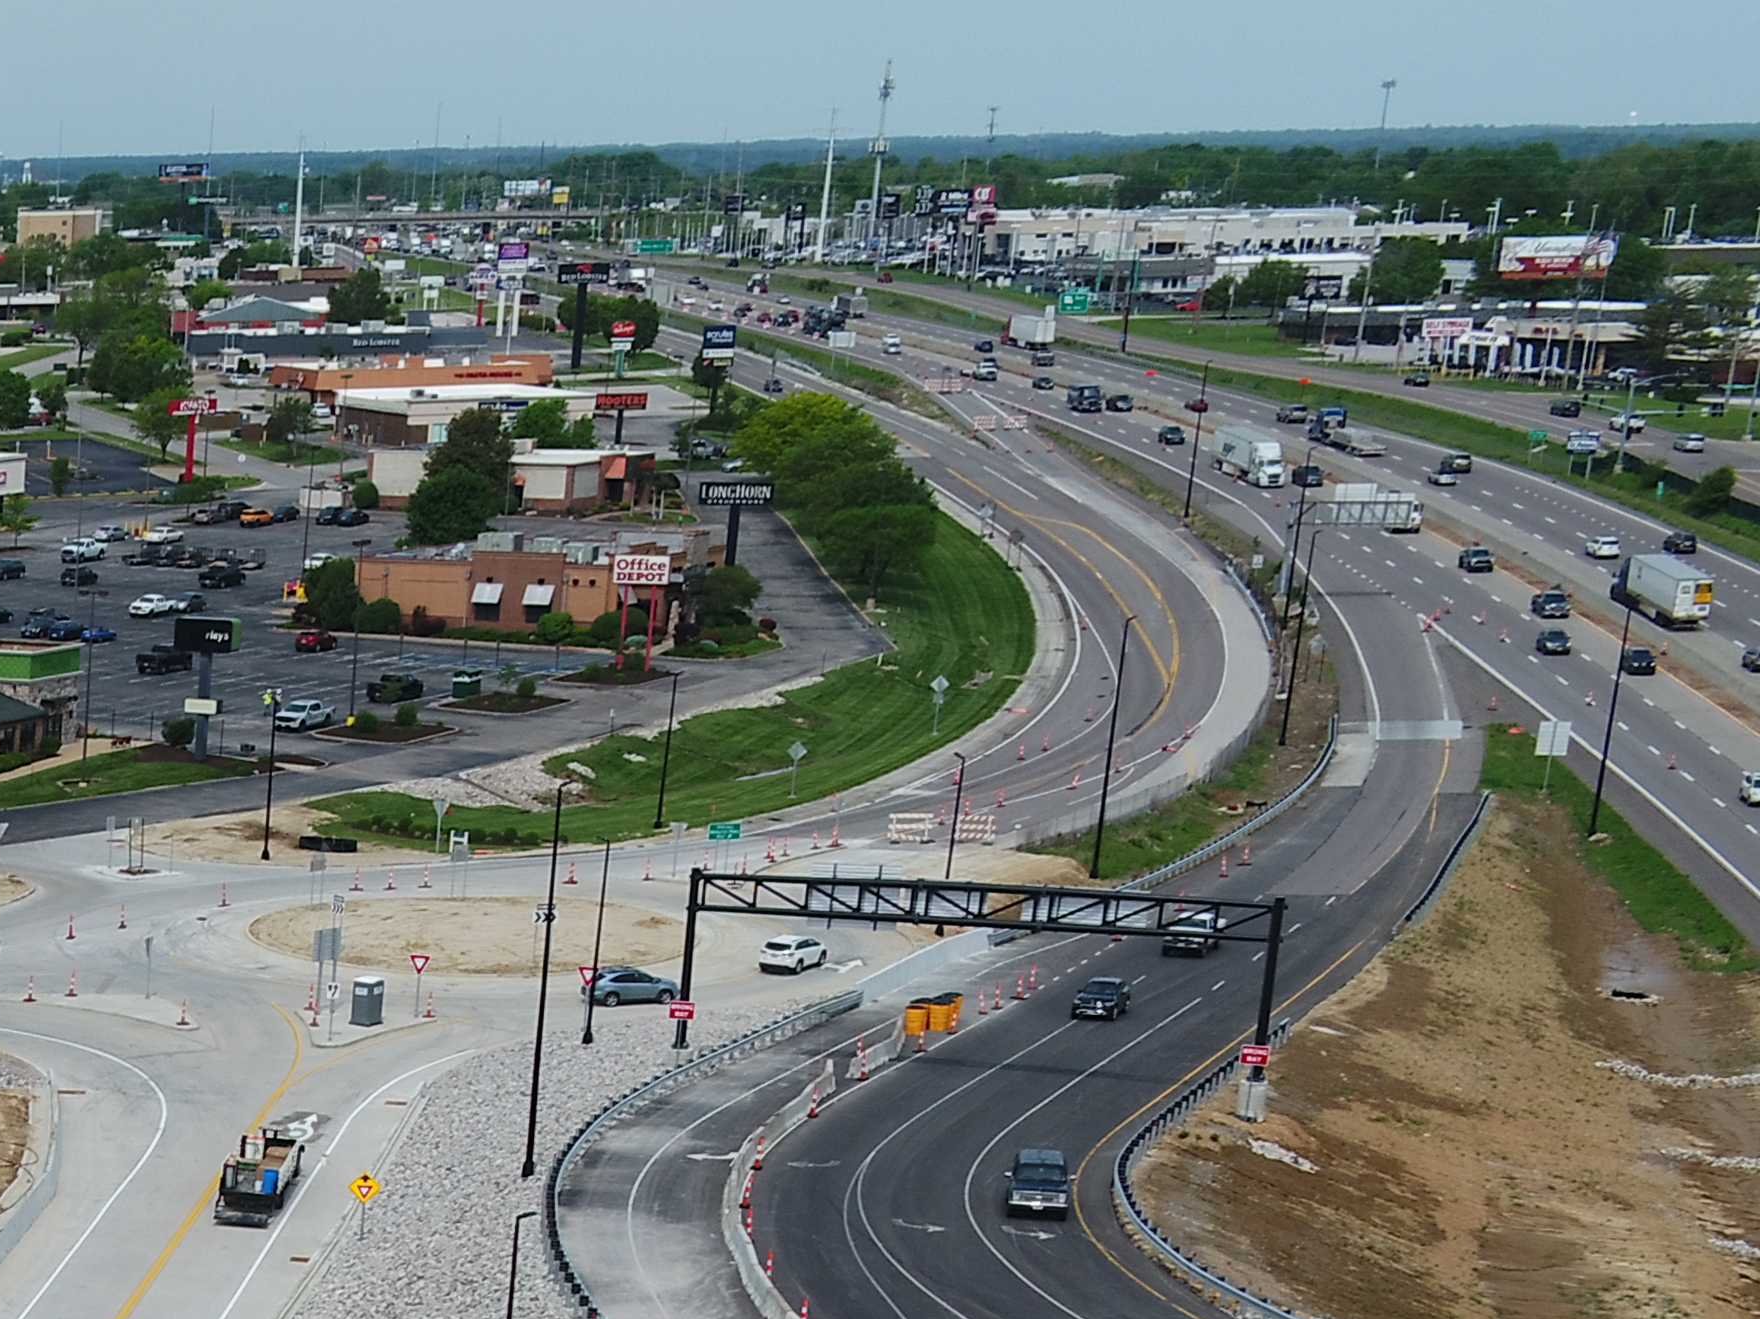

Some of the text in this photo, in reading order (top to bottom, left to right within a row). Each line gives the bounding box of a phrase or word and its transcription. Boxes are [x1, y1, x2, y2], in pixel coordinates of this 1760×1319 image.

[352, 337, 401, 347] RED LOBSTER
[598, 394, 647, 405] HOOTERS
[701, 484, 772, 499] LONGHORN
[616, 558, 667, 571] Office
[616, 572, 665, 582] DEPOT
